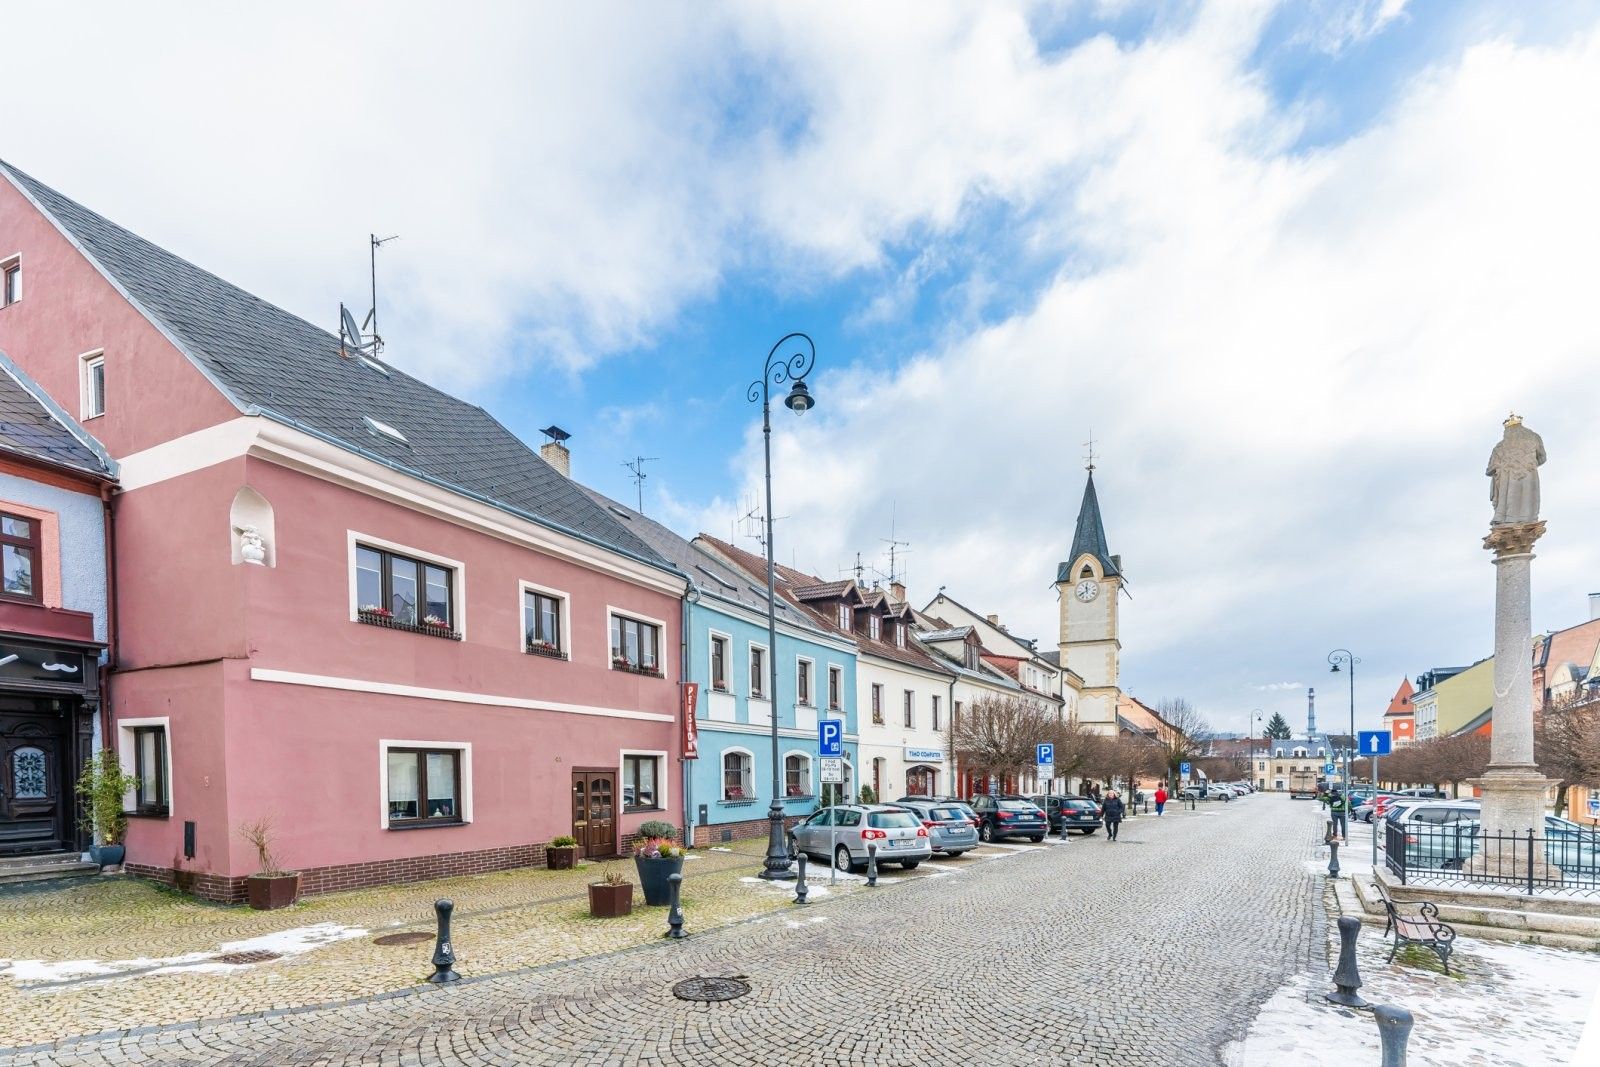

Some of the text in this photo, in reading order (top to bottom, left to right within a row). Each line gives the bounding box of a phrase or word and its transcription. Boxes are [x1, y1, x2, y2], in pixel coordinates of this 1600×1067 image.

[824, 724, 838, 746] P
[1041, 746, 1051, 759] P
[1327, 765, 1334, 773] P
